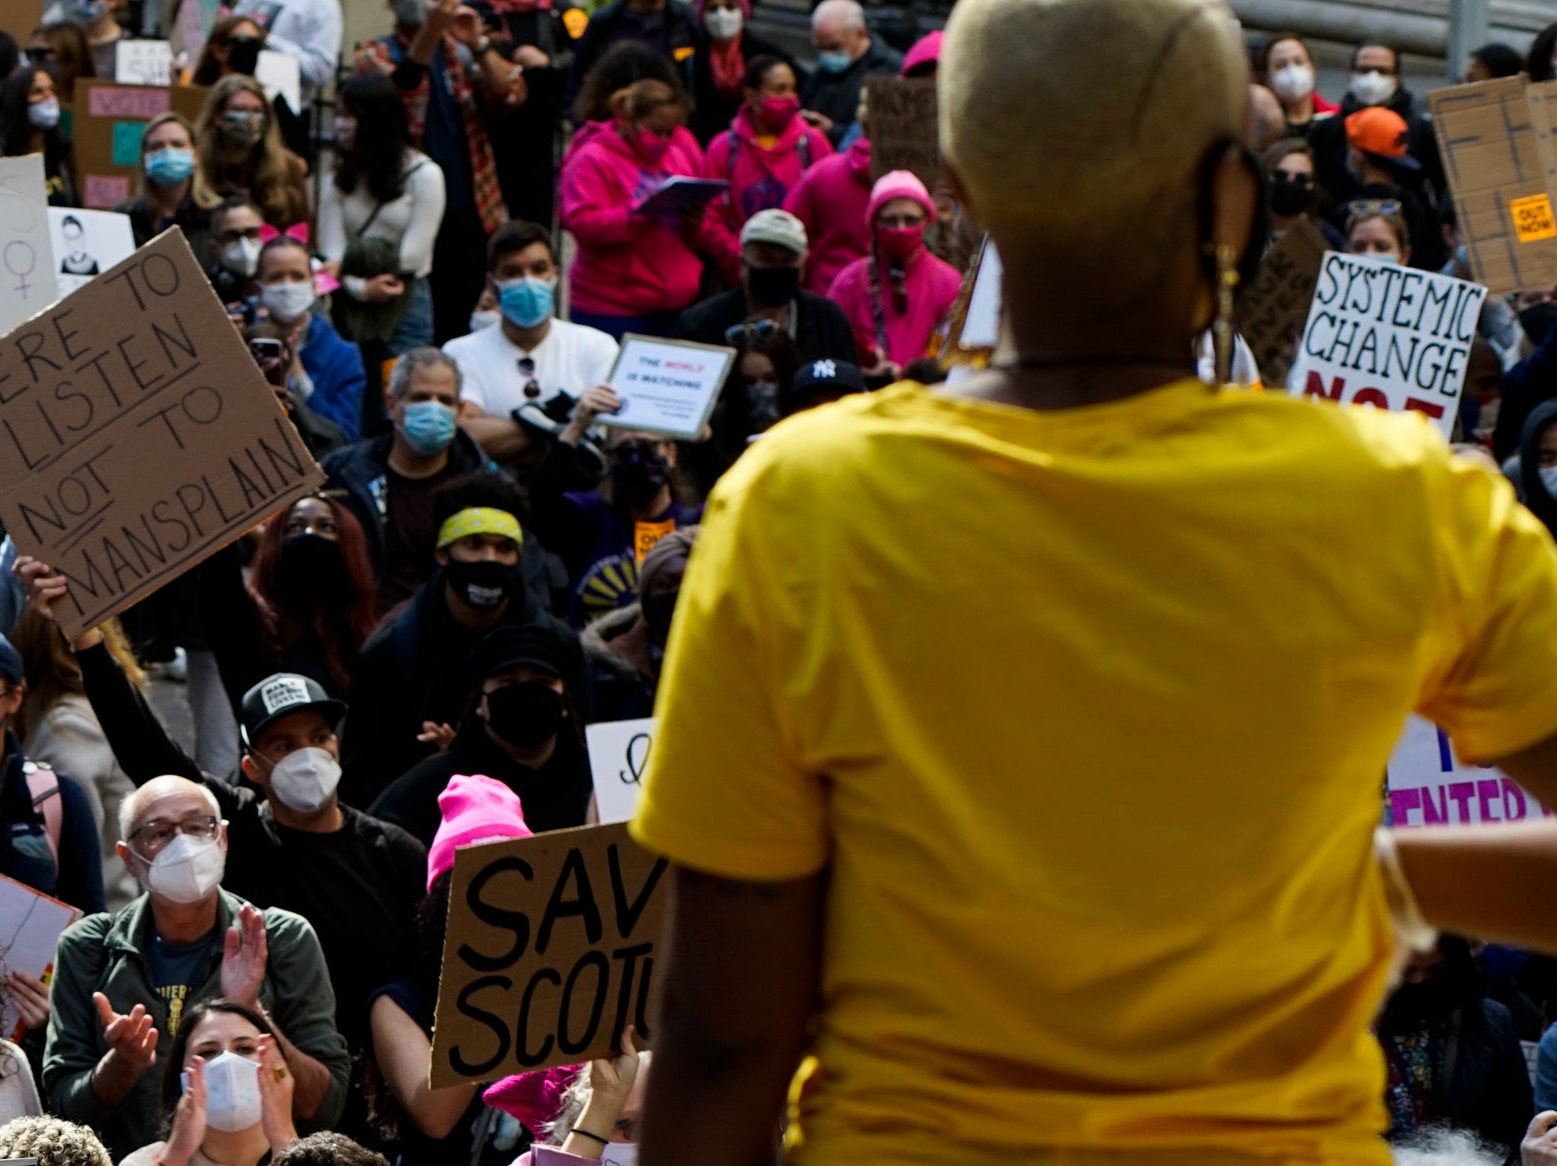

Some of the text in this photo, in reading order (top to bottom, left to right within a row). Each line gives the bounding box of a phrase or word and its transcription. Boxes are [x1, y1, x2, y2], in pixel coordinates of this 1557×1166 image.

[104, 252, 179, 311] TO
[1317, 255, 1482, 345] SYSTEMIC
[3, 312, 198, 470] LISTEN
[1306, 311, 1466, 397] CHANGE
[18, 385, 223, 546] NOT TO
[53, 417, 307, 617] MANSPLAIN
[457, 843, 670, 972] SAV
